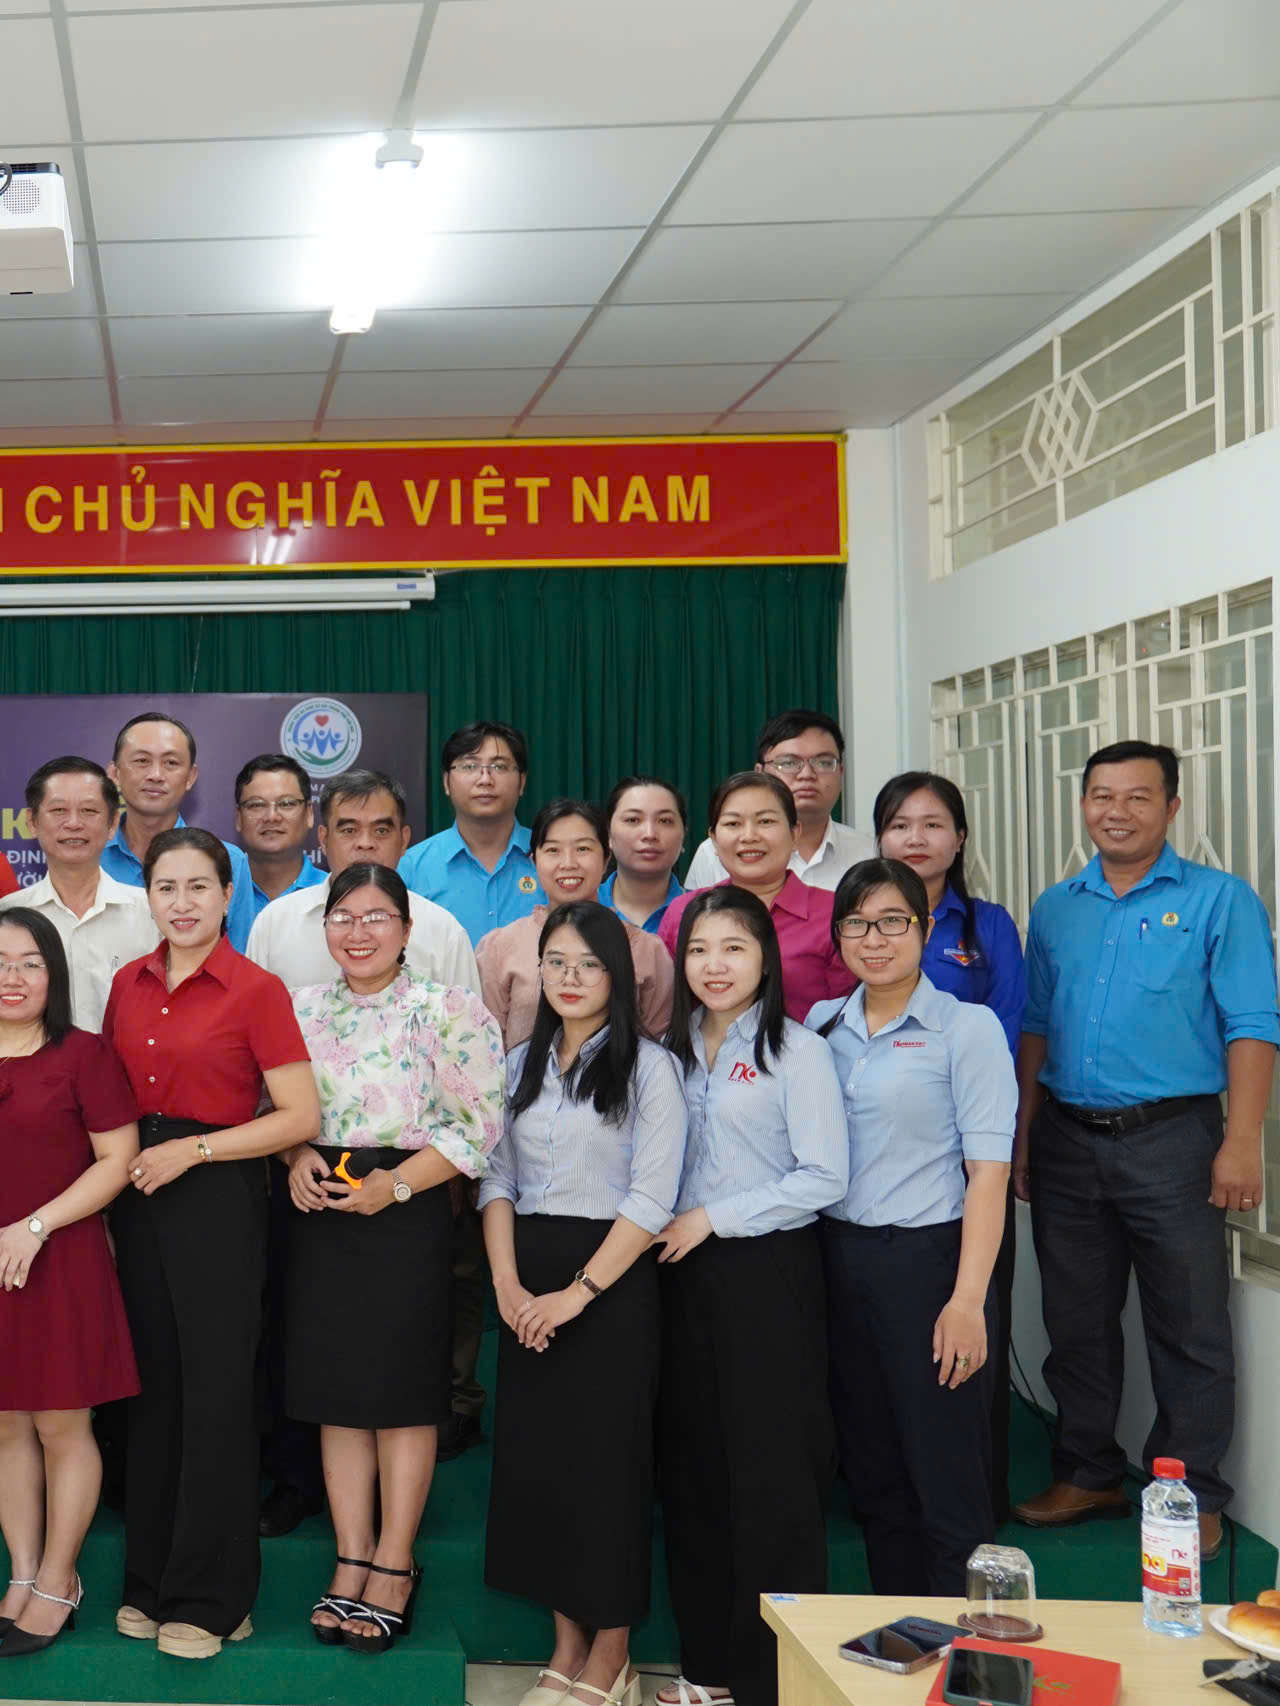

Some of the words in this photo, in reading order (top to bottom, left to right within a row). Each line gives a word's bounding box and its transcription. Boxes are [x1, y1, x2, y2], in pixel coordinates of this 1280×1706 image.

[25, 466, 157, 533] CHỦ
[180, 469, 385, 531] NGHĨA
[404, 464, 550, 536] VIỆT
[573, 475, 710, 524] NAM
